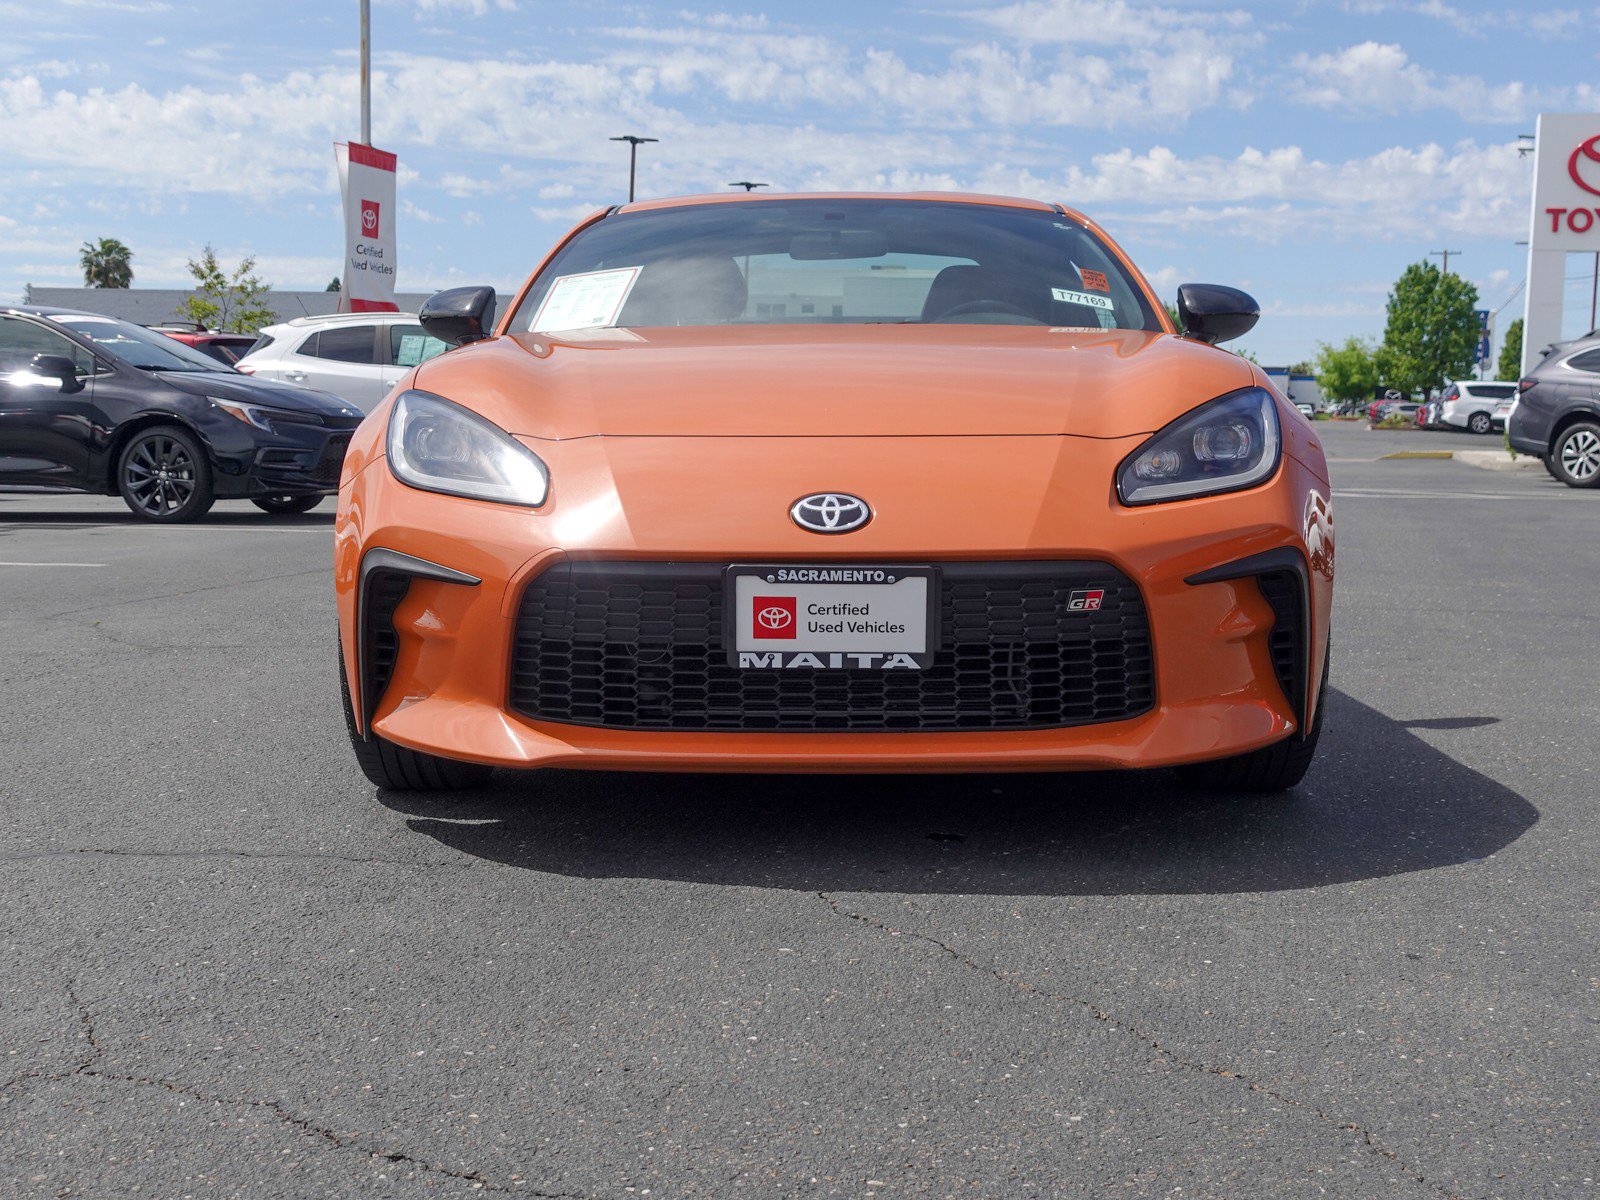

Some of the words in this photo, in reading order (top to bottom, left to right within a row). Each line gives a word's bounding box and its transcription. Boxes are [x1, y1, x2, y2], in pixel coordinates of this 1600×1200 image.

[356, 244, 383, 258] Cerfed
[351, 257, 368, 271] Ued
[369, 260, 393, 275] Vicles
[1057, 290, 1106, 307] T77169
[777, 569, 885, 582] SACRAMENTO
[807, 603, 869, 615] Certified
[1070, 598, 1099, 609] GR
[807, 621, 843, 633] Used
[846, 621, 905, 633] Vehicles
[739, 652, 921, 669] MAITA
